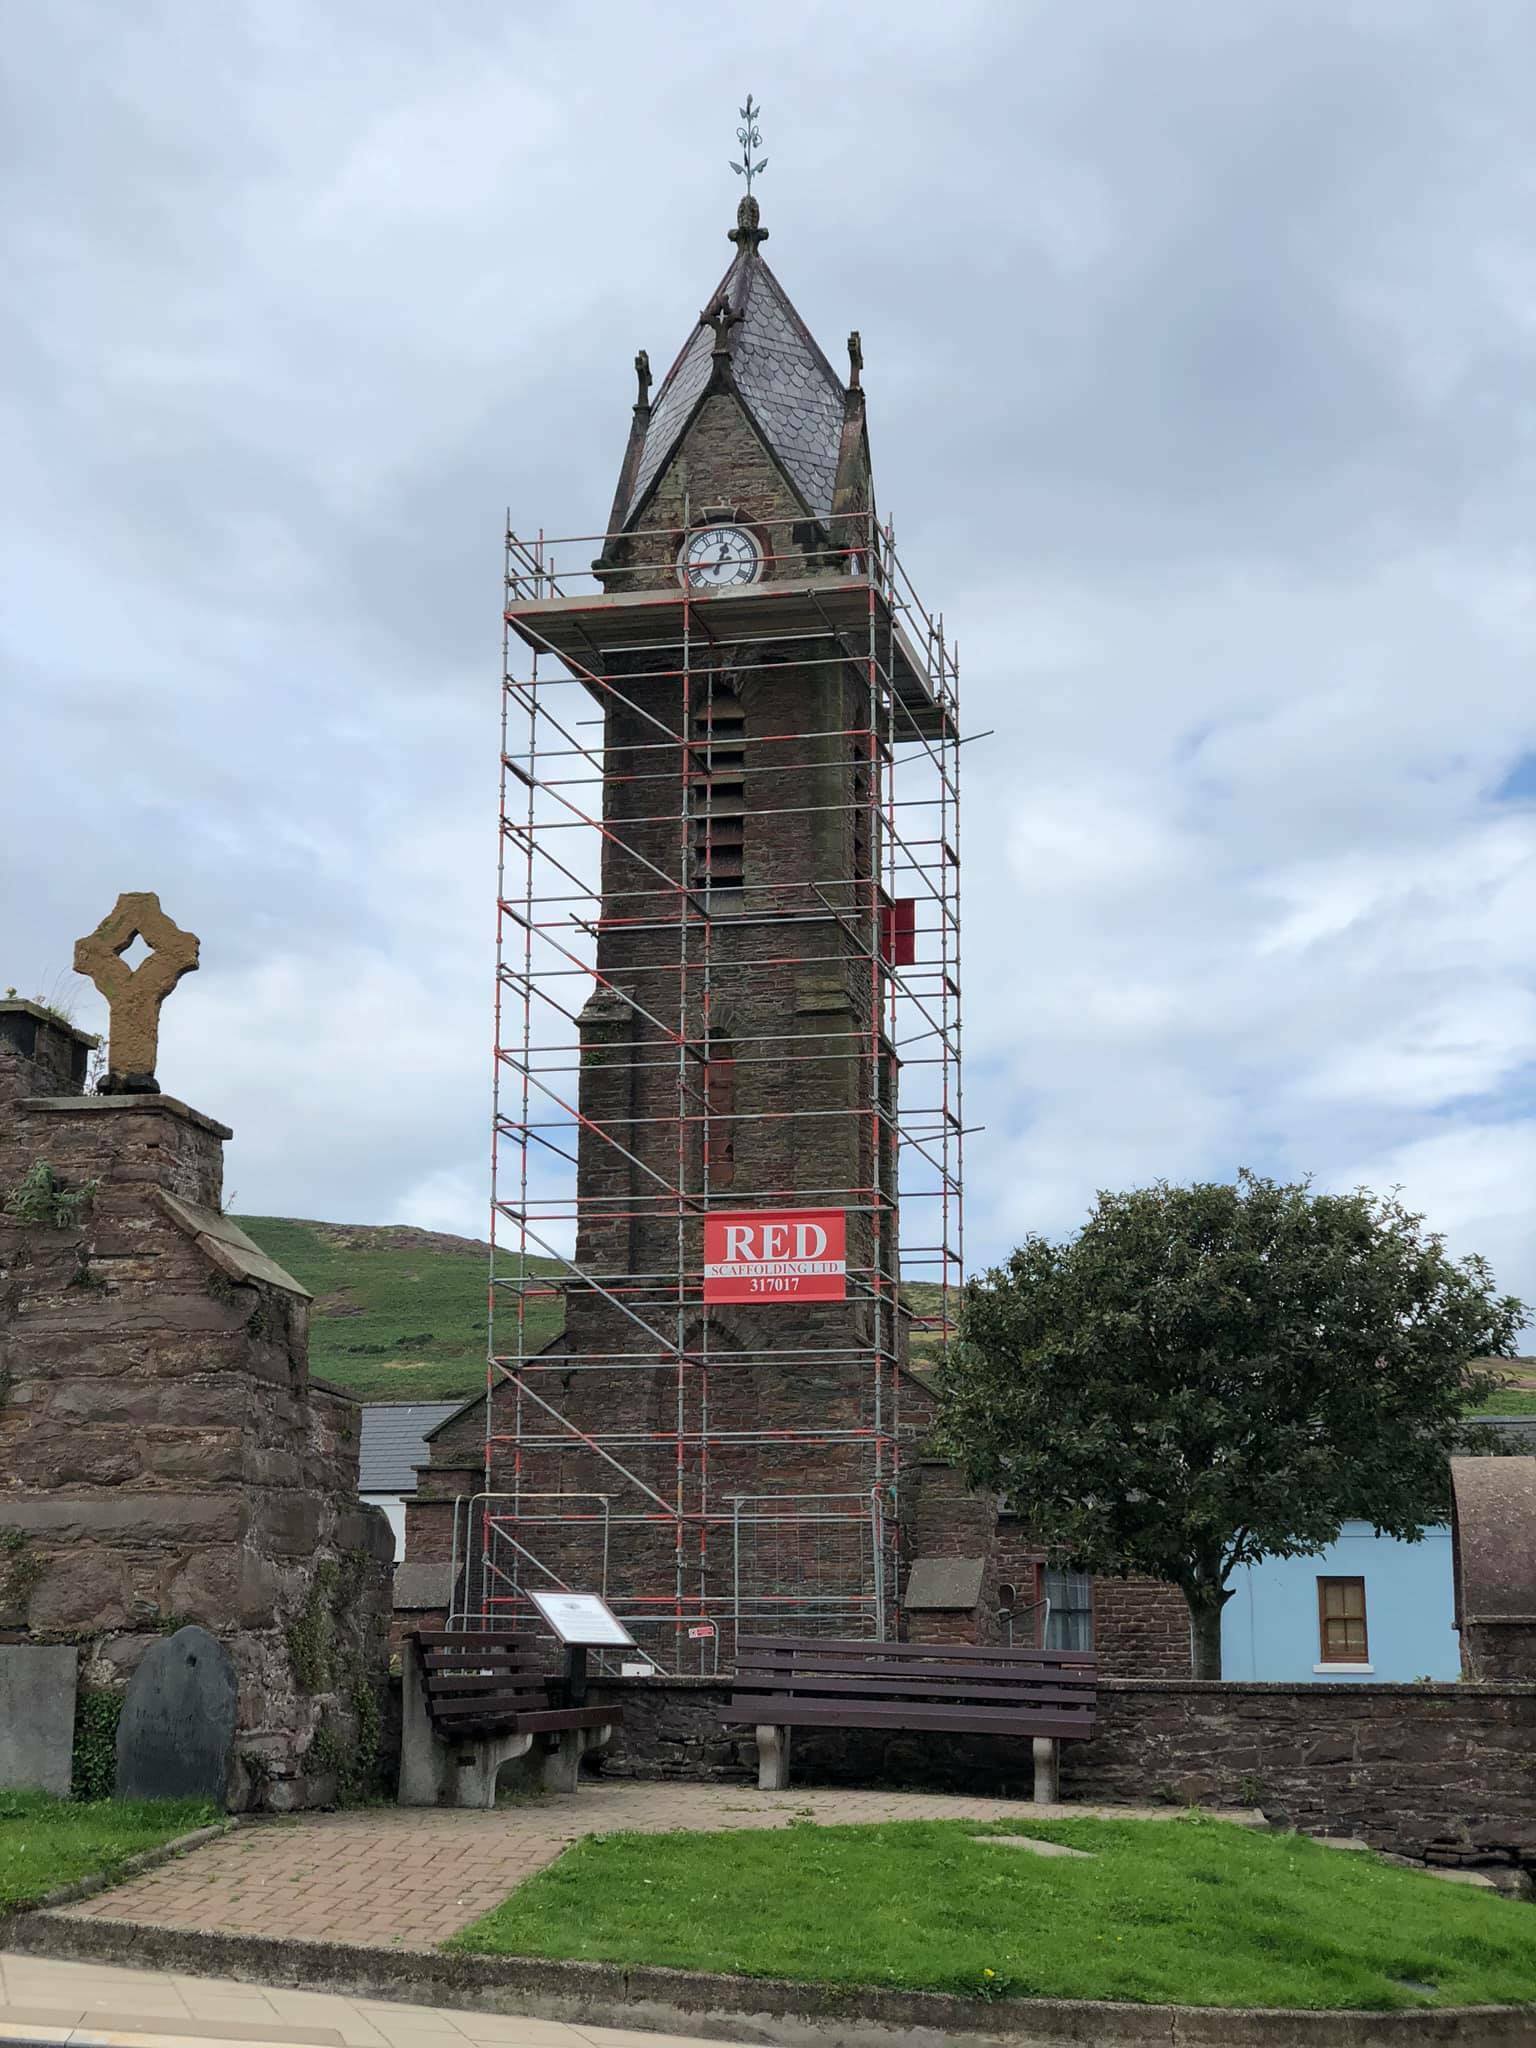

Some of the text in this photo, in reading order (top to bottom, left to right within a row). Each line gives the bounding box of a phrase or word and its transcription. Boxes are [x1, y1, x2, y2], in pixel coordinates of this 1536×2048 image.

[722, 1223, 827, 1262] RED
[711, 1262, 838, 1276] SCAFFOLDING LTD
[750, 1277, 800, 1292] 317017
